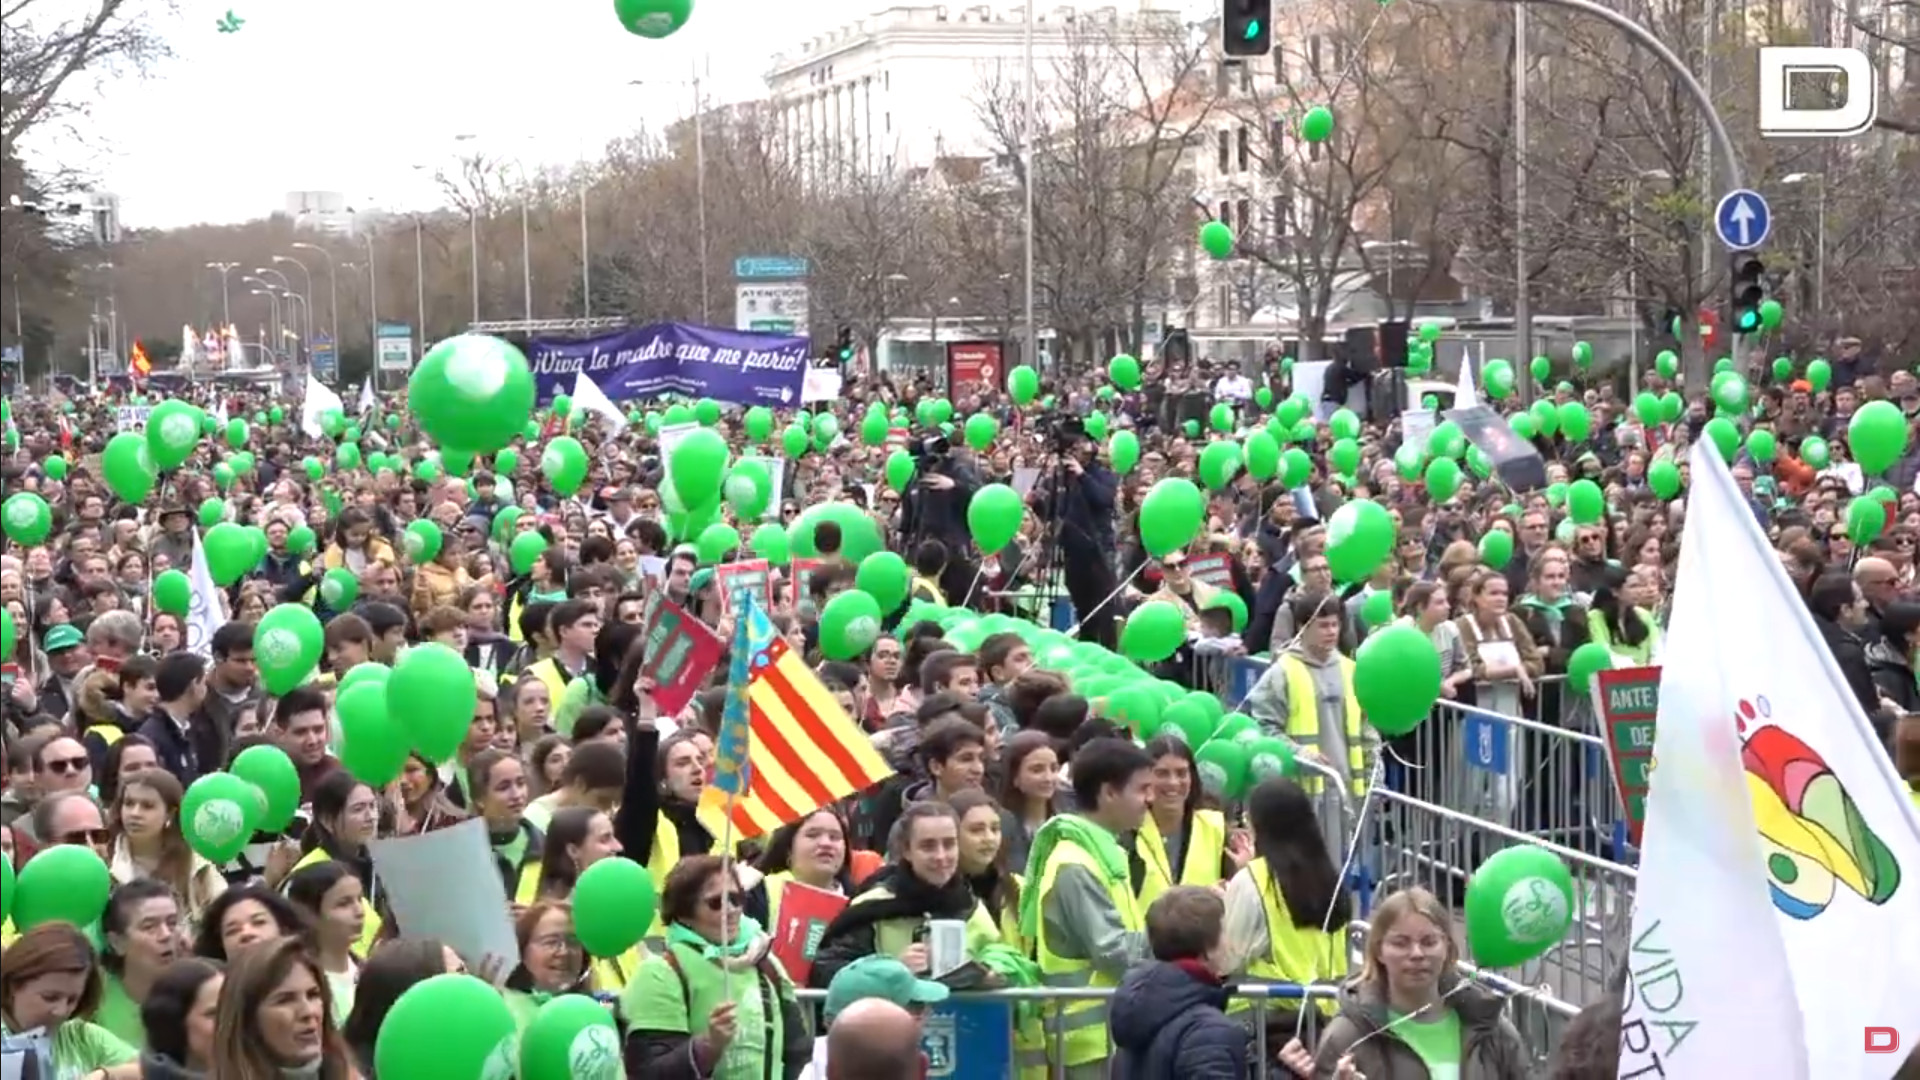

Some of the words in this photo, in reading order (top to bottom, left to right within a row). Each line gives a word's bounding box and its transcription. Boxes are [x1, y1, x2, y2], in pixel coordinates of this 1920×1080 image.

[592, 346, 609, 371] la
[614, 335, 673, 366] madre
[675, 344, 710, 365] que
[712, 343, 741, 365] me
[741, 341, 805, 373] parió!
[1609, 687, 1650, 709] ANTE
[1632, 919, 1699, 1057] VIDA
